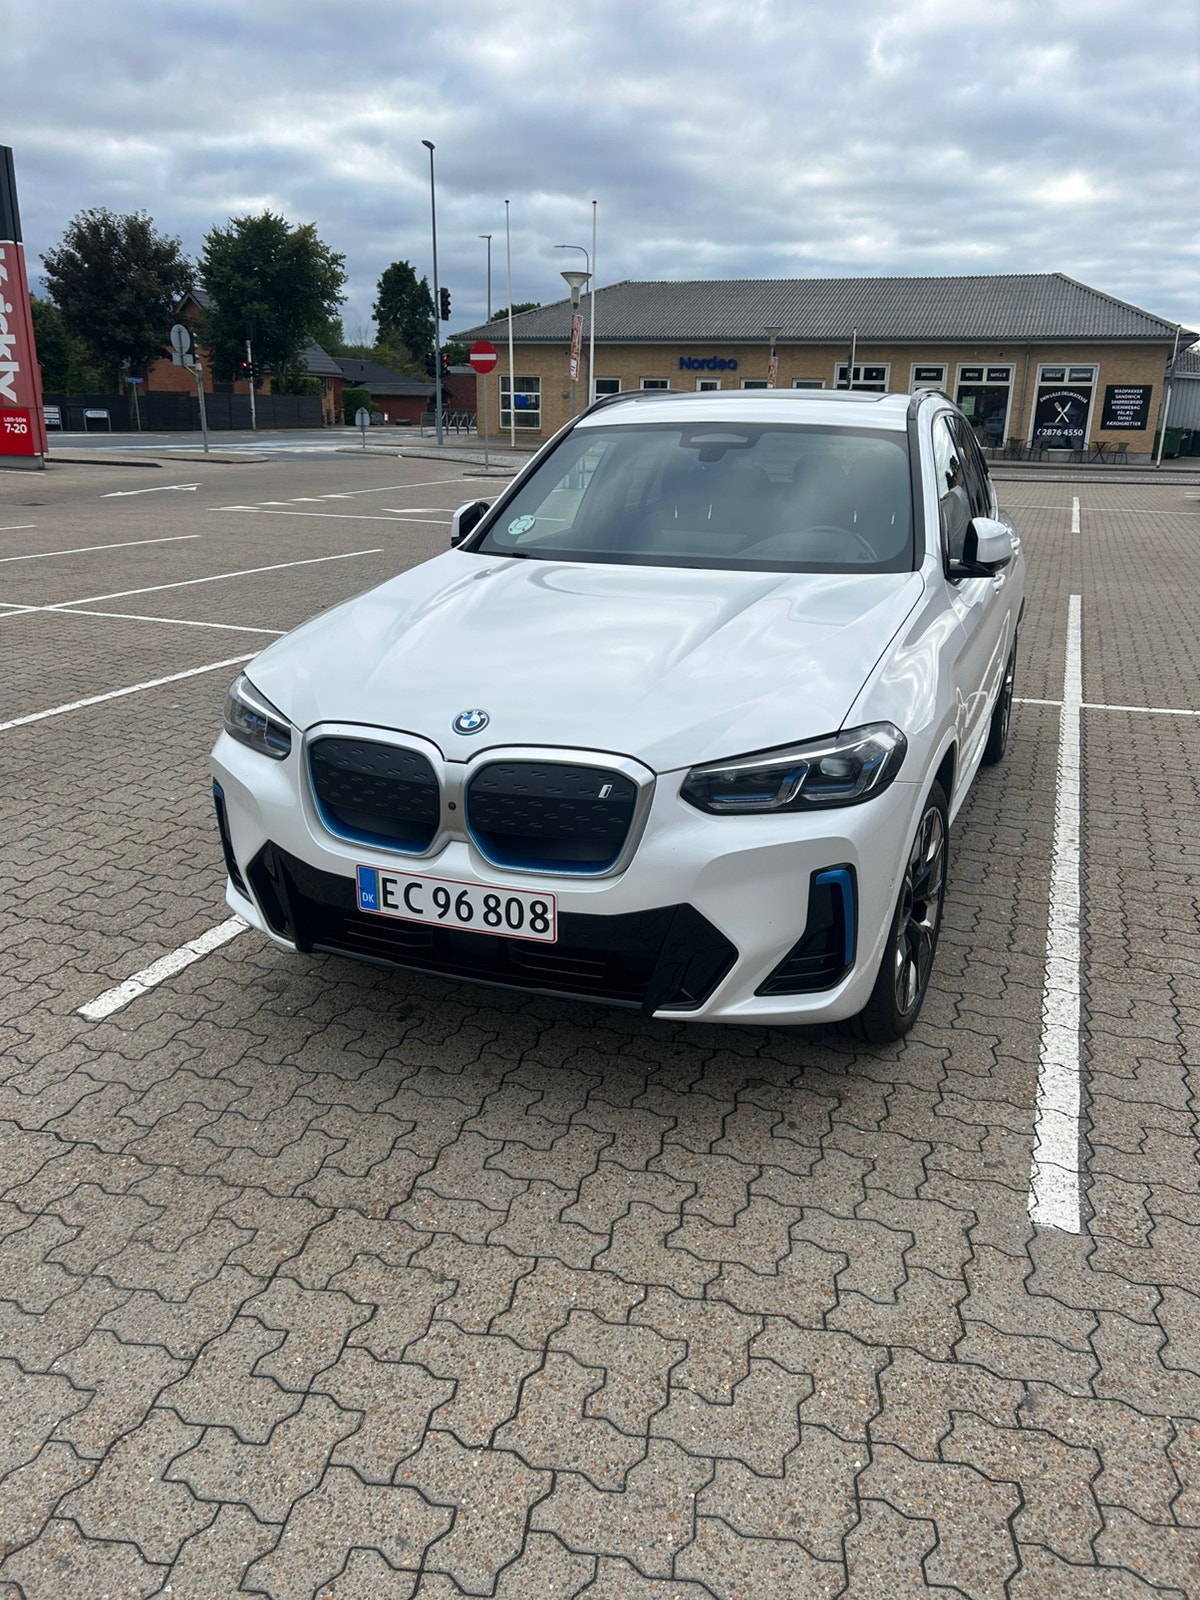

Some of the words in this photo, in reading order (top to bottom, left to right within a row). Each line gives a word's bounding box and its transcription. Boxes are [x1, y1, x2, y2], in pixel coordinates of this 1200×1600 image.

[679, 355, 738, 371] Nordea
[4, 423, 28, 434] 7-20
[1041, 428, 1062, 436] 2876
[1063, 428, 1084, 436] 4550
[362, 892, 375, 904] DK
[381, 877, 424, 914] EC
[432, 886, 474, 922] 96
[482, 893, 550, 934] 808
